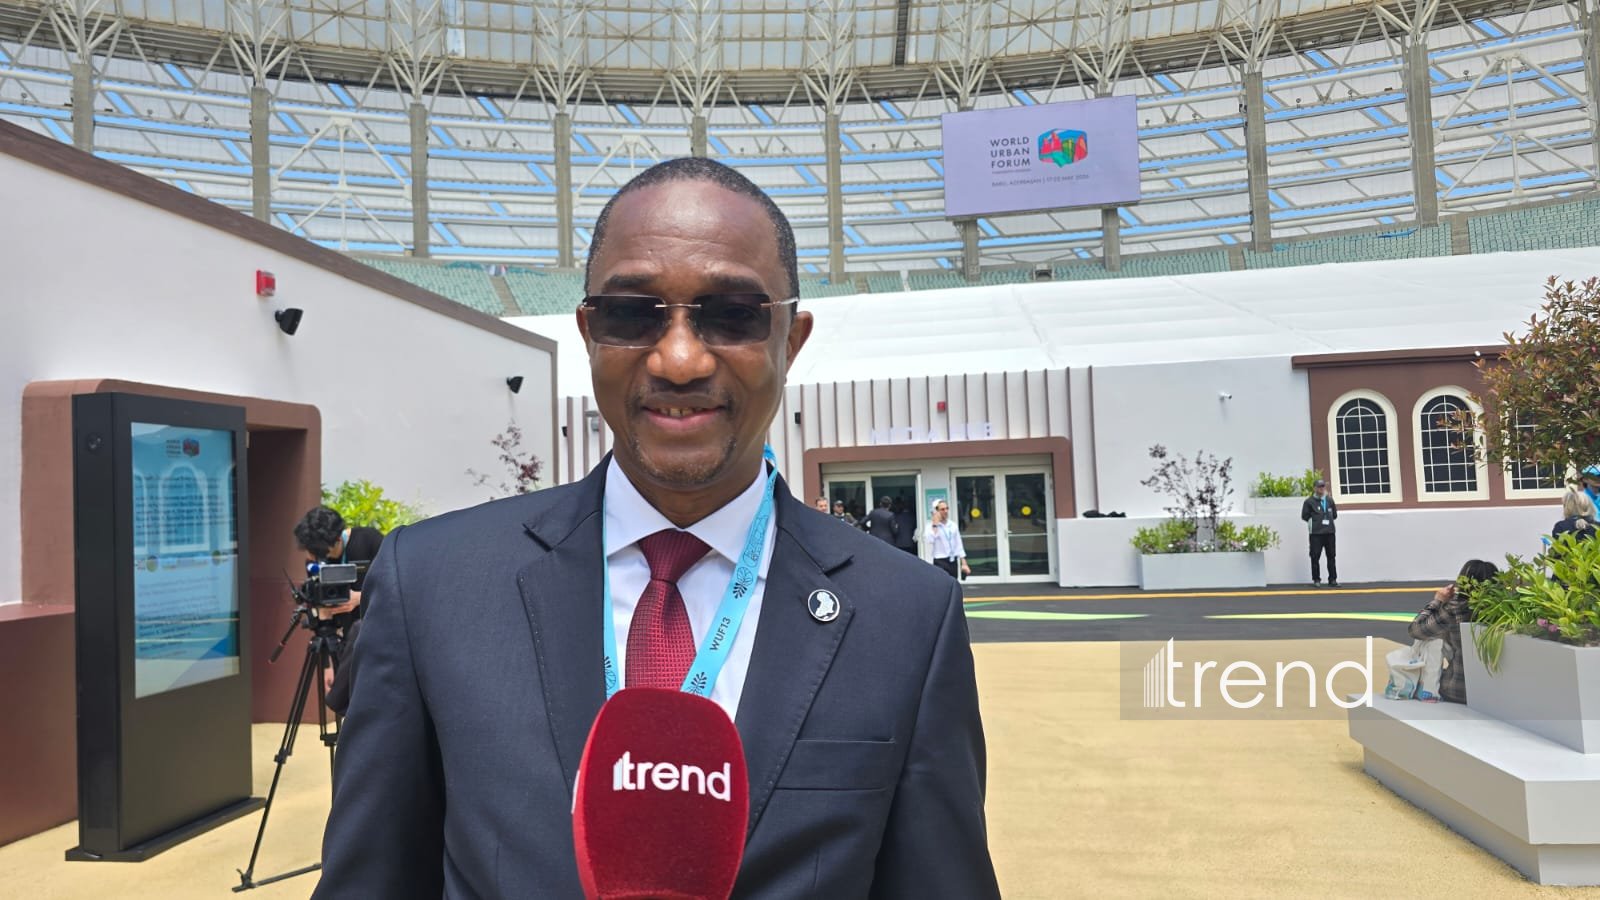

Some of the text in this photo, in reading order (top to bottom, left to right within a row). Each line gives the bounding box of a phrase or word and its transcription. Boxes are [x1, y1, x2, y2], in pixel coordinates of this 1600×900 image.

[990, 136, 1030, 147] WORLD
[990, 147, 1030, 158] URBAN
[991, 159, 1031, 168] FORUM
[709, 617, 732, 652] WUF13
[613, 751, 732, 802] trend
